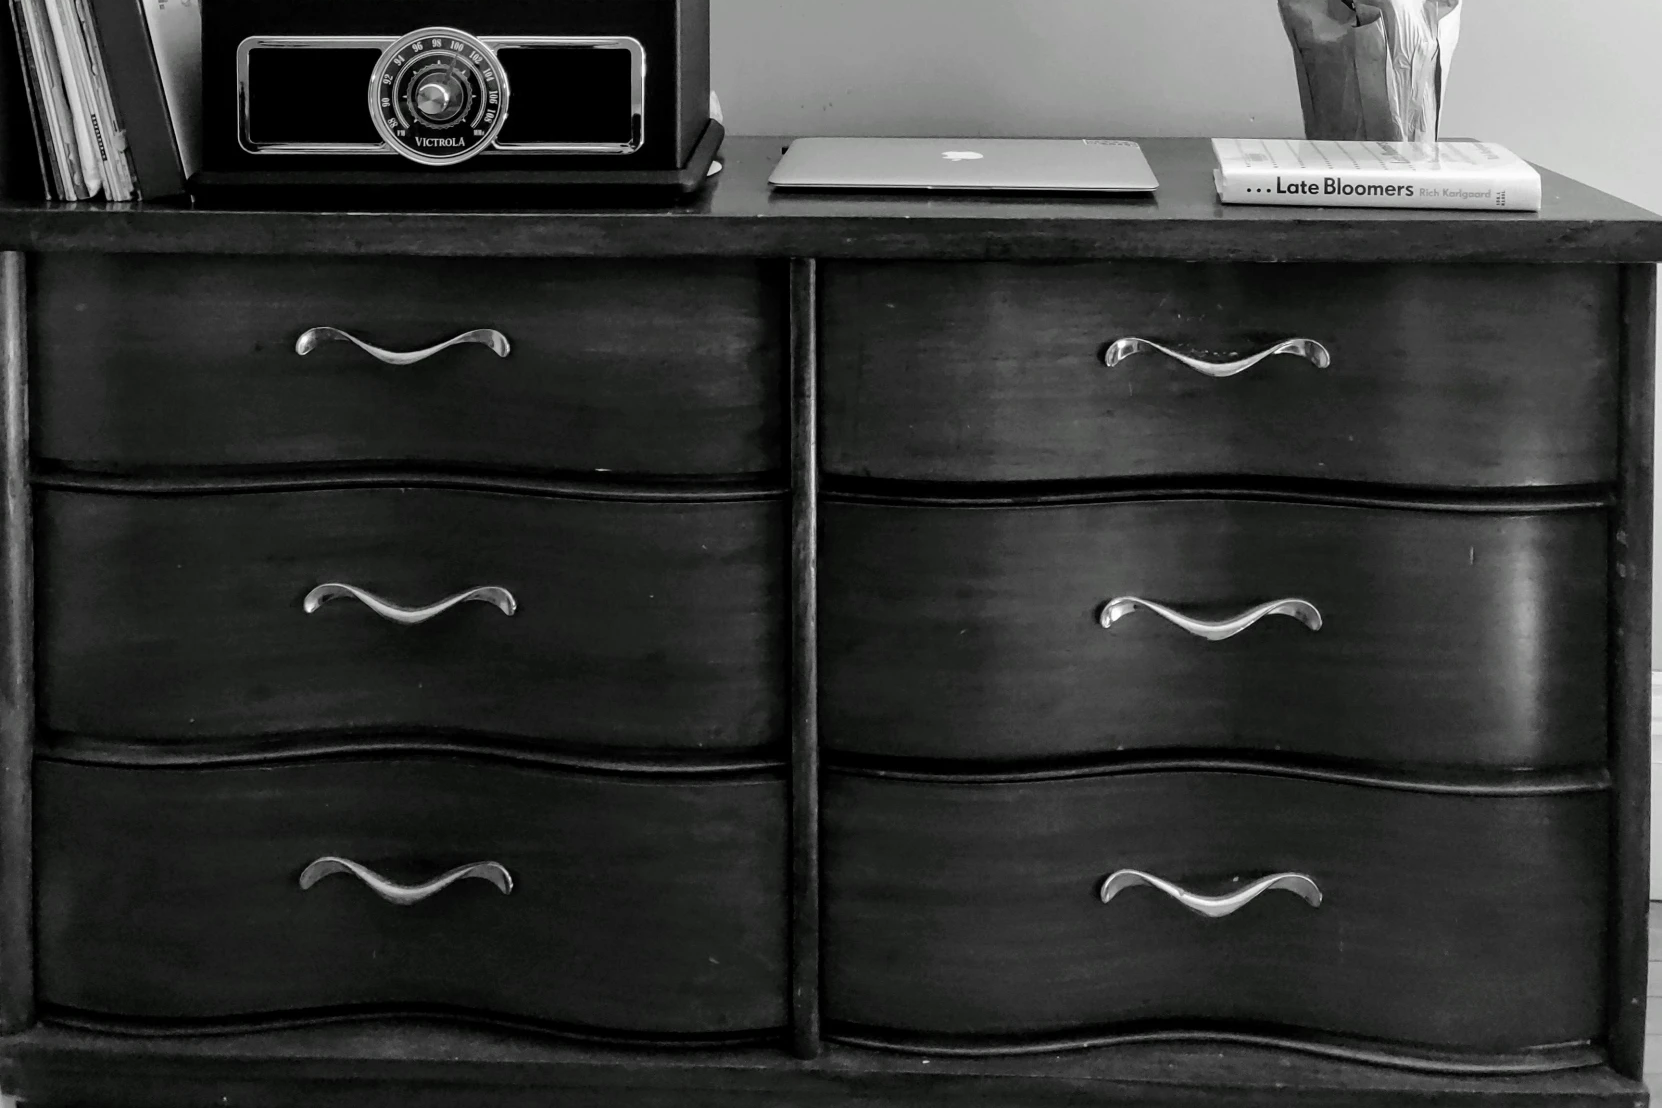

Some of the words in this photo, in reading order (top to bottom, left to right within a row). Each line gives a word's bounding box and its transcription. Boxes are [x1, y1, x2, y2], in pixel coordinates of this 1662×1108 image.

[412, 42, 423, 52] 96
[432, 39, 442, 47] 98
[450, 41, 464, 51] 100
[469, 51, 483, 65] 102
[382, 73, 393, 85] 92
[381, 97, 390, 108] 90
[489, 90, 498, 104] 106
[484, 108, 496, 124] 108
[387, 117, 398, 129] 88
[415, 136, 465, 147] VICTROLA
[1276, 176, 1319, 194] Late
[1323, 177, 1414, 197] Bloomers
[1419, 188, 1439, 197] Rich
[1442, 188, 1491, 200] Karlgaard
